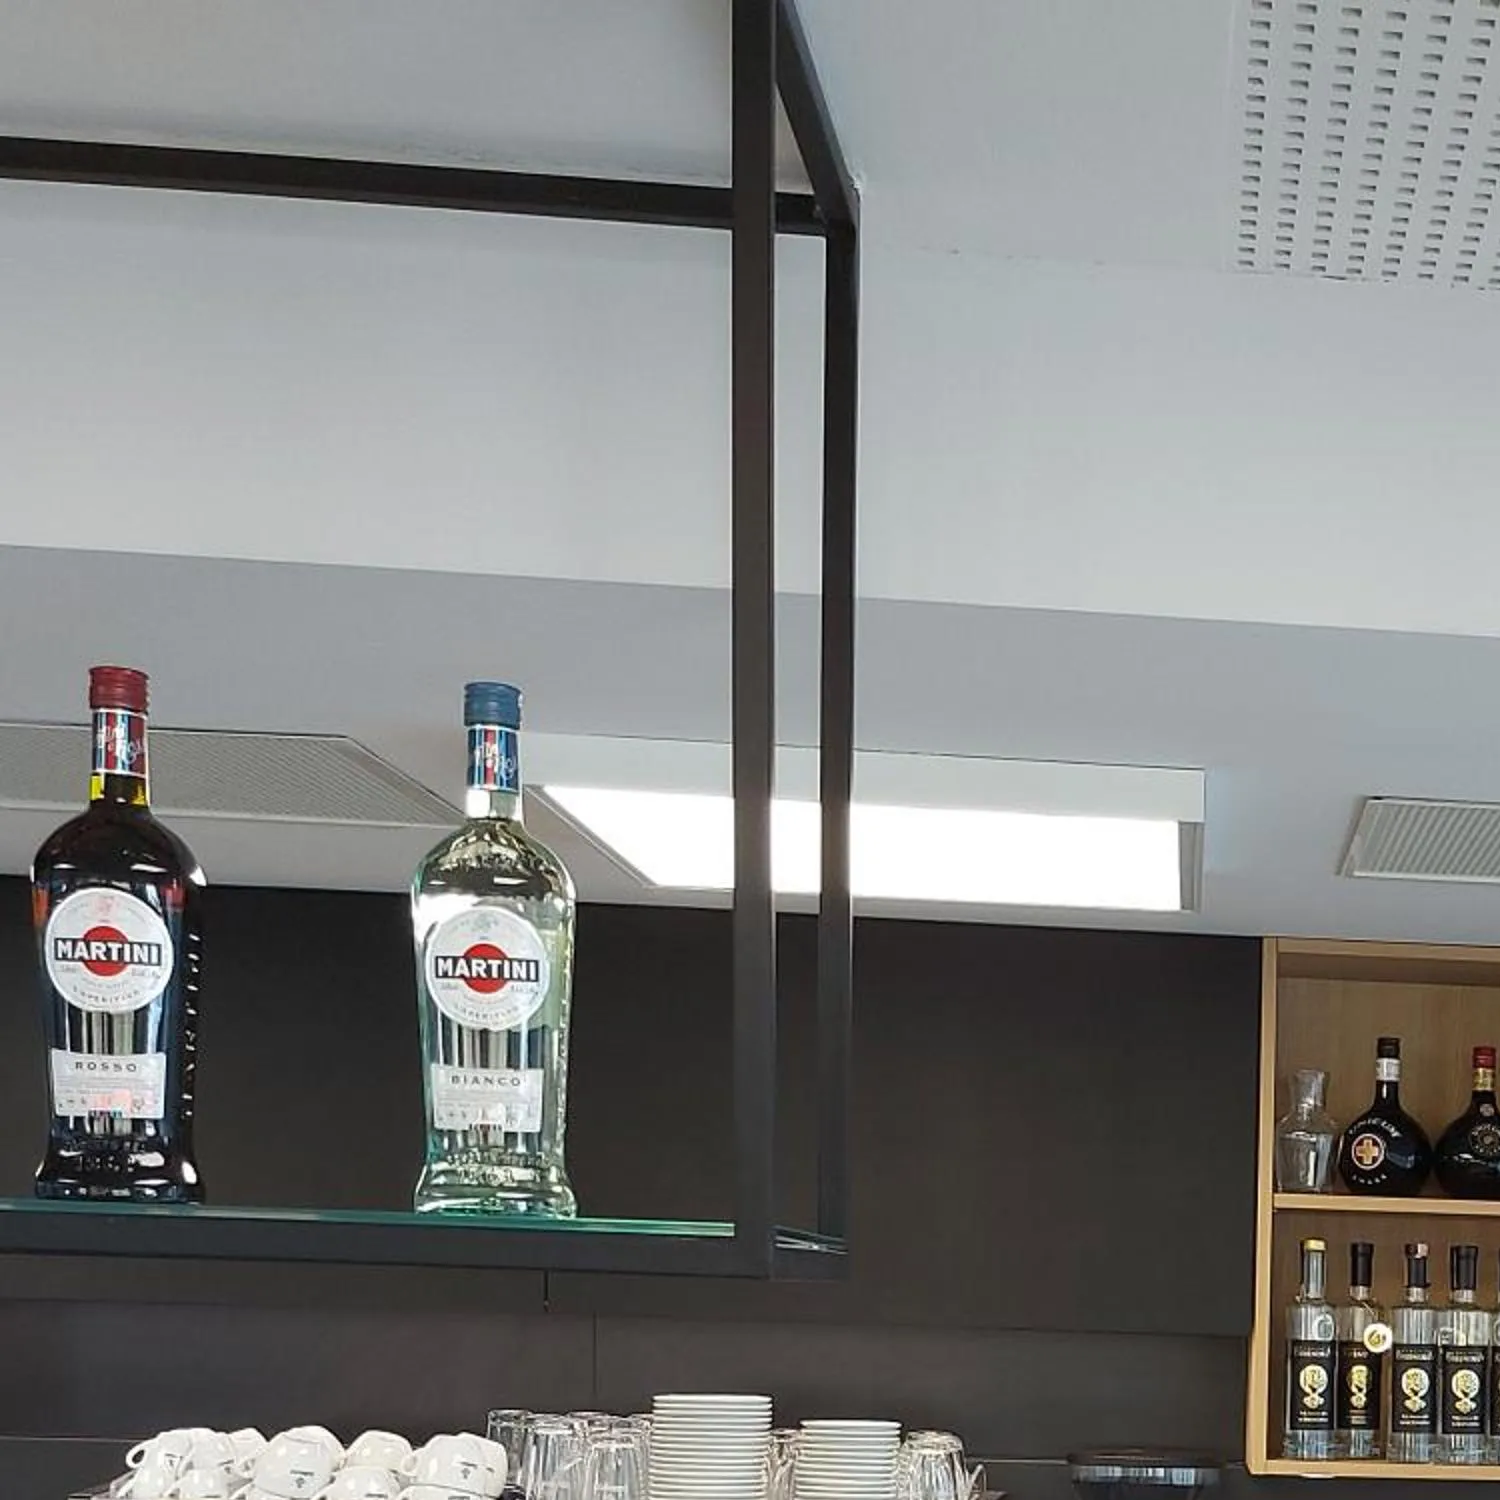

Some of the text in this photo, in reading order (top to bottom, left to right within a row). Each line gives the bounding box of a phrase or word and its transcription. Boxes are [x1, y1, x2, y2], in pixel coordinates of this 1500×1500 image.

[57, 938, 159, 964] MARTINI
[437, 957, 536, 981] MARTINI
[75, 1061, 137, 1072] ROSSO
[451, 1075, 521, 1087] BIANCO
